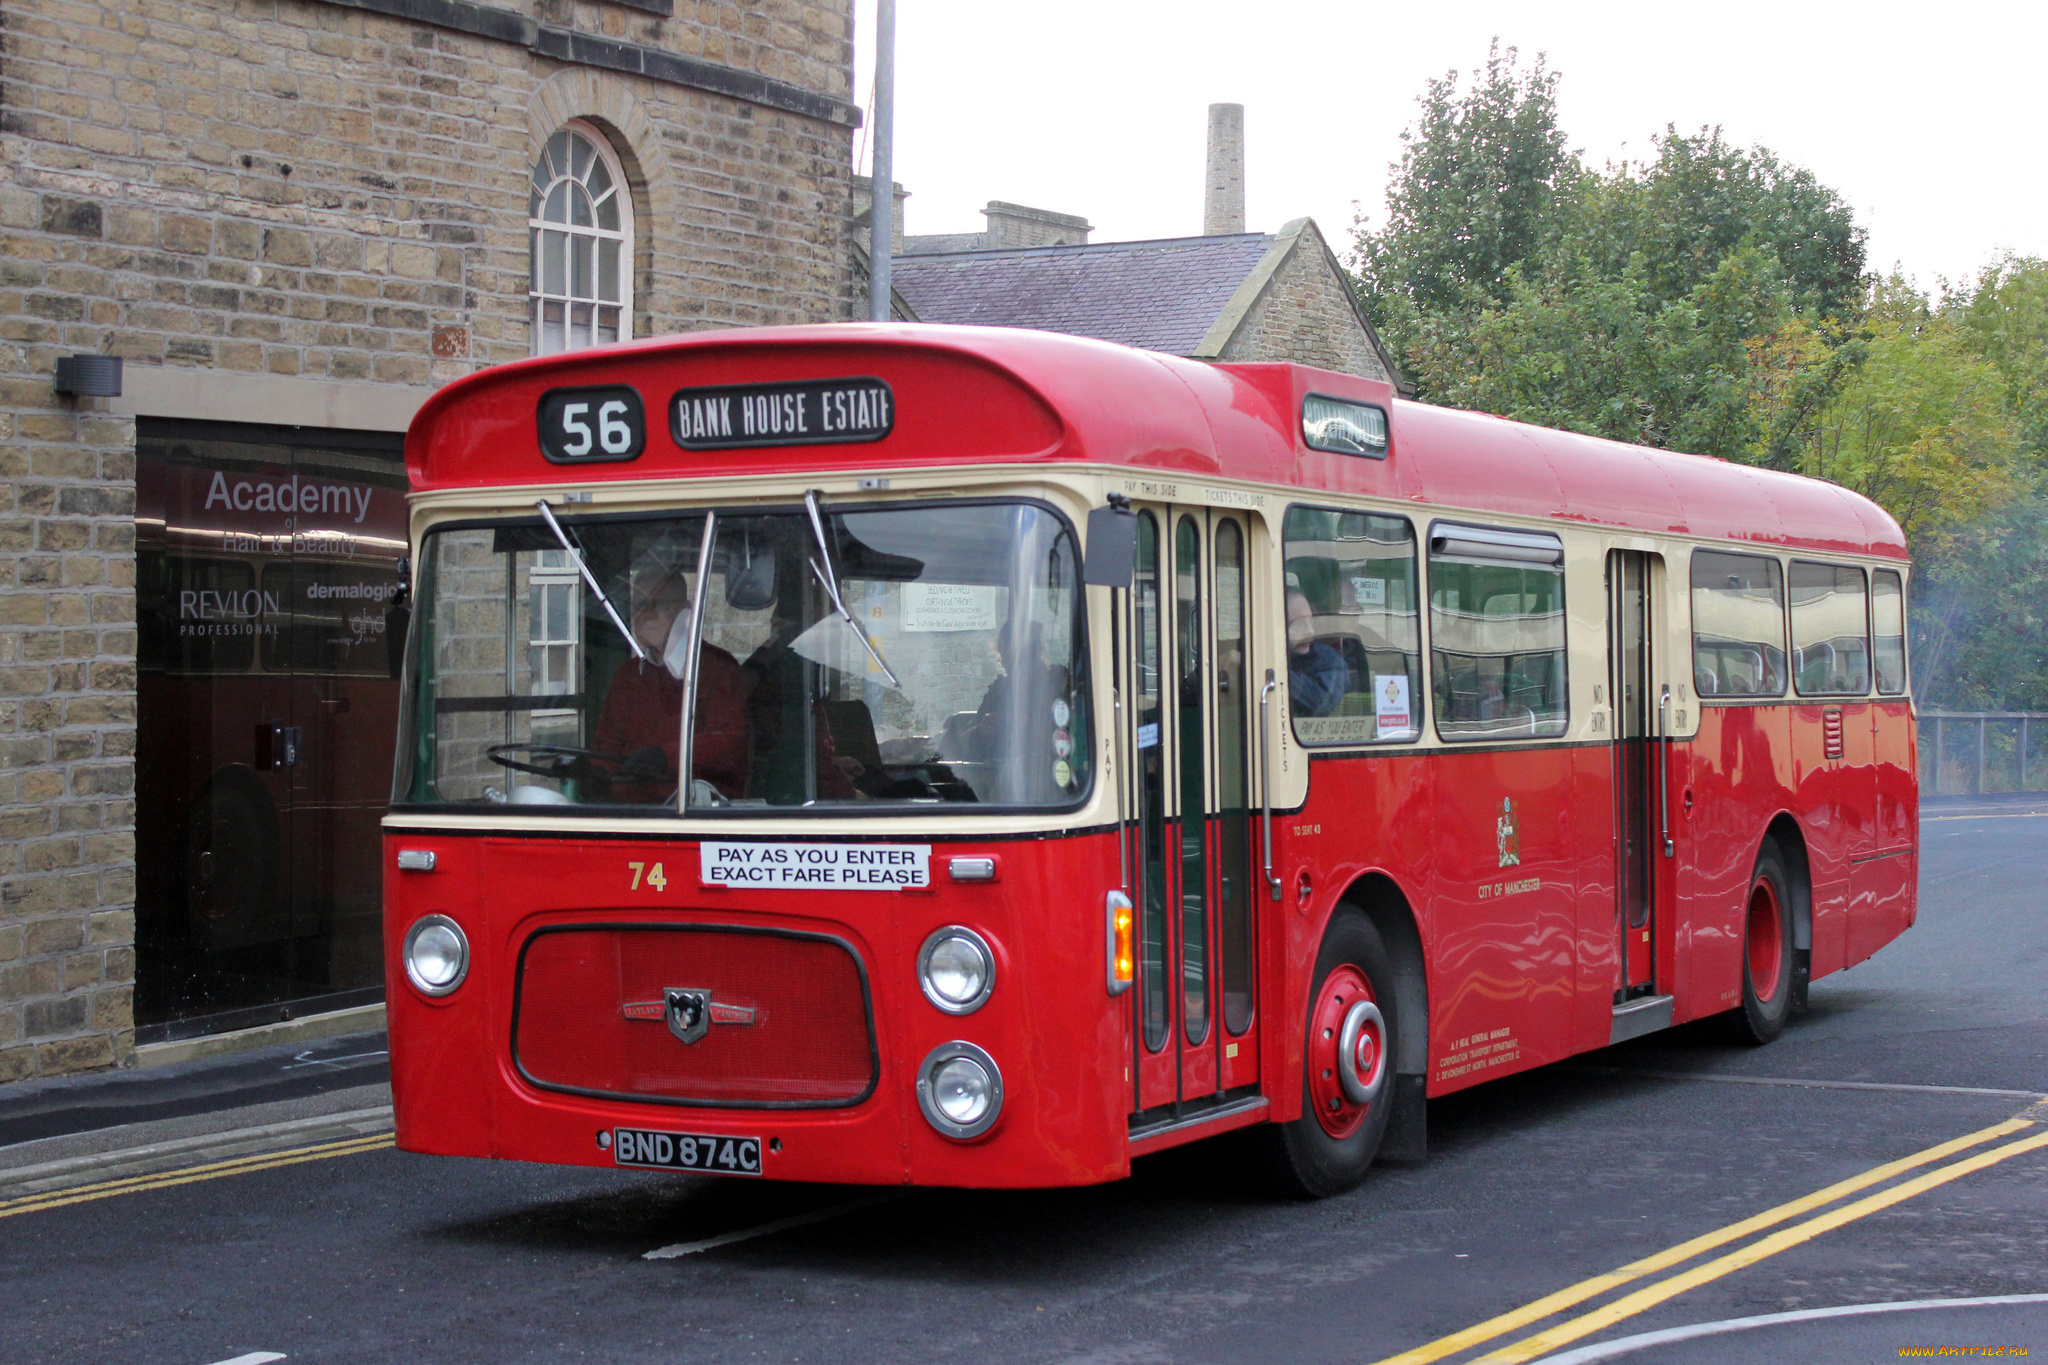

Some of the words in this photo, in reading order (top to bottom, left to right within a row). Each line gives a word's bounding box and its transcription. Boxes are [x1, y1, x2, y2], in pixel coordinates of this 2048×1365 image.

[678, 397, 732, 439] BANK
[743, 393, 808, 435] HOUSE
[822, 388, 890, 431] ESTATE
[563, 400, 632, 456] 56
[204, 471, 373, 523] Academy
[1124, 481, 1137, 492] PAY
[1141, 482, 1157, 495] THIS
[1160, 484, 1177, 497] SIDE
[1205, 489, 1233, 503] TICKETS
[1233, 493, 1249, 505] THIS
[1250, 494, 1265, 506] SIDE
[285, 516, 298, 529] of
[223, 530, 262, 552] Hair
[271, 532, 284, 553] &
[293, 532, 357, 559] Beauty
[307, 582, 398, 601] dermalogic
[180, 589, 280, 619] REVLON
[872, 606, 882, 618] 8
[180, 624, 279, 636] PROFESSIONAL
[351, 607, 386, 645] ghd
[1593, 684, 1602, 704] NO
[1677, 683, 1686, 702] NO
[1279, 682, 1288, 772] TICKETS
[1301, 721, 1315, 735] PAY
[1315, 721, 1326, 735] AS
[1328, 720, 1343, 734] YOU
[1341, 720, 1365, 734] ENTER
[1592, 712, 1605, 732] ENTRY
[1293, 826, 1301, 836] TO
[1302, 825, 1313, 835] SEAT
[718, 848, 756, 862] PAY
[760, 849, 788, 863] AS
[794, 849, 839, 864] YOU
[846, 850, 915, 865] ENTER
[628, 861, 667, 892] 74
[711, 866, 777, 882] EXACT
[782, 867, 835, 883] FARE
[843, 869, 924, 885] PLEASE
[1478, 884, 1493, 899] CITY
[1494, 882, 1503, 896] OF
[1504, 877, 1540, 894] MANCHESTER
[627, 1006, 661, 1016] LEYLAND
[716, 1009, 749, 1020] PANTHER
[1471, 1031, 1489, 1044] GENERAL
[1490, 1027, 1510, 1039] MANAGER
[1439, 1052, 1468, 1067] CORPORATION
[1469, 1045, 1492, 1059] TRANSPORT
[1492, 1038, 1518, 1053] DEPARTMENT
[617, 1131, 673, 1164] BND
[679, 1137, 757, 1171] 874C
